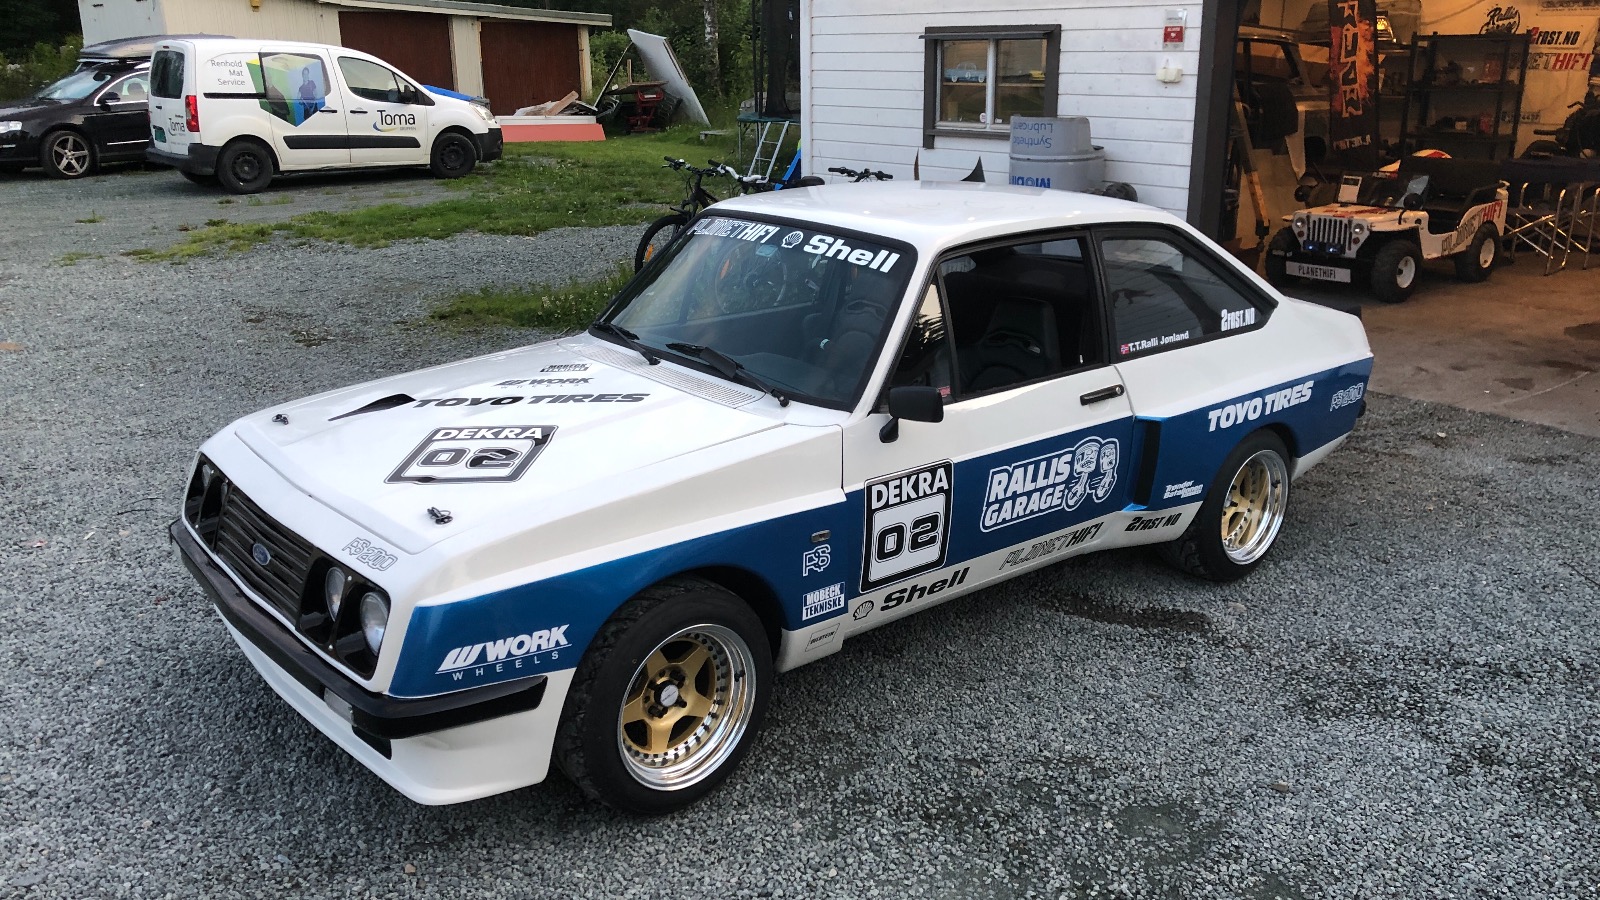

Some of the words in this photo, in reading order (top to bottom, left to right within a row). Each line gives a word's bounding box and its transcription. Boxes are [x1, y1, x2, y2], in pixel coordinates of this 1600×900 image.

[210, 59, 243, 68] Renhold
[228, 69, 244, 77] Mat
[217, 78, 246, 86] Service
[376, 109, 416, 125] Toma
[803, 234, 901, 273] Shell
[1298, 265, 1336, 279] PLANETHIFI
[413, 396, 525, 408] TOYO
[526, 393, 651, 404] TIRES
[1208, 397, 1263, 432] TOYO
[1264, 380, 1314, 416] TIRES
[431, 427, 543, 440] DEKRA
[416, 447, 522, 470] 02
[871, 467, 949, 510] DEKRA
[988, 453, 1073, 502] RALLIS
[984, 488, 1066, 527] GARAGE
[875, 512, 941, 563] 02
[802, 544, 831, 577] RS
[880, 567, 970, 612] Shell
[804, 596, 842, 618] TEKNISKE
[486, 624, 570, 662] WORK
[452, 651, 559, 681] WHEELS
